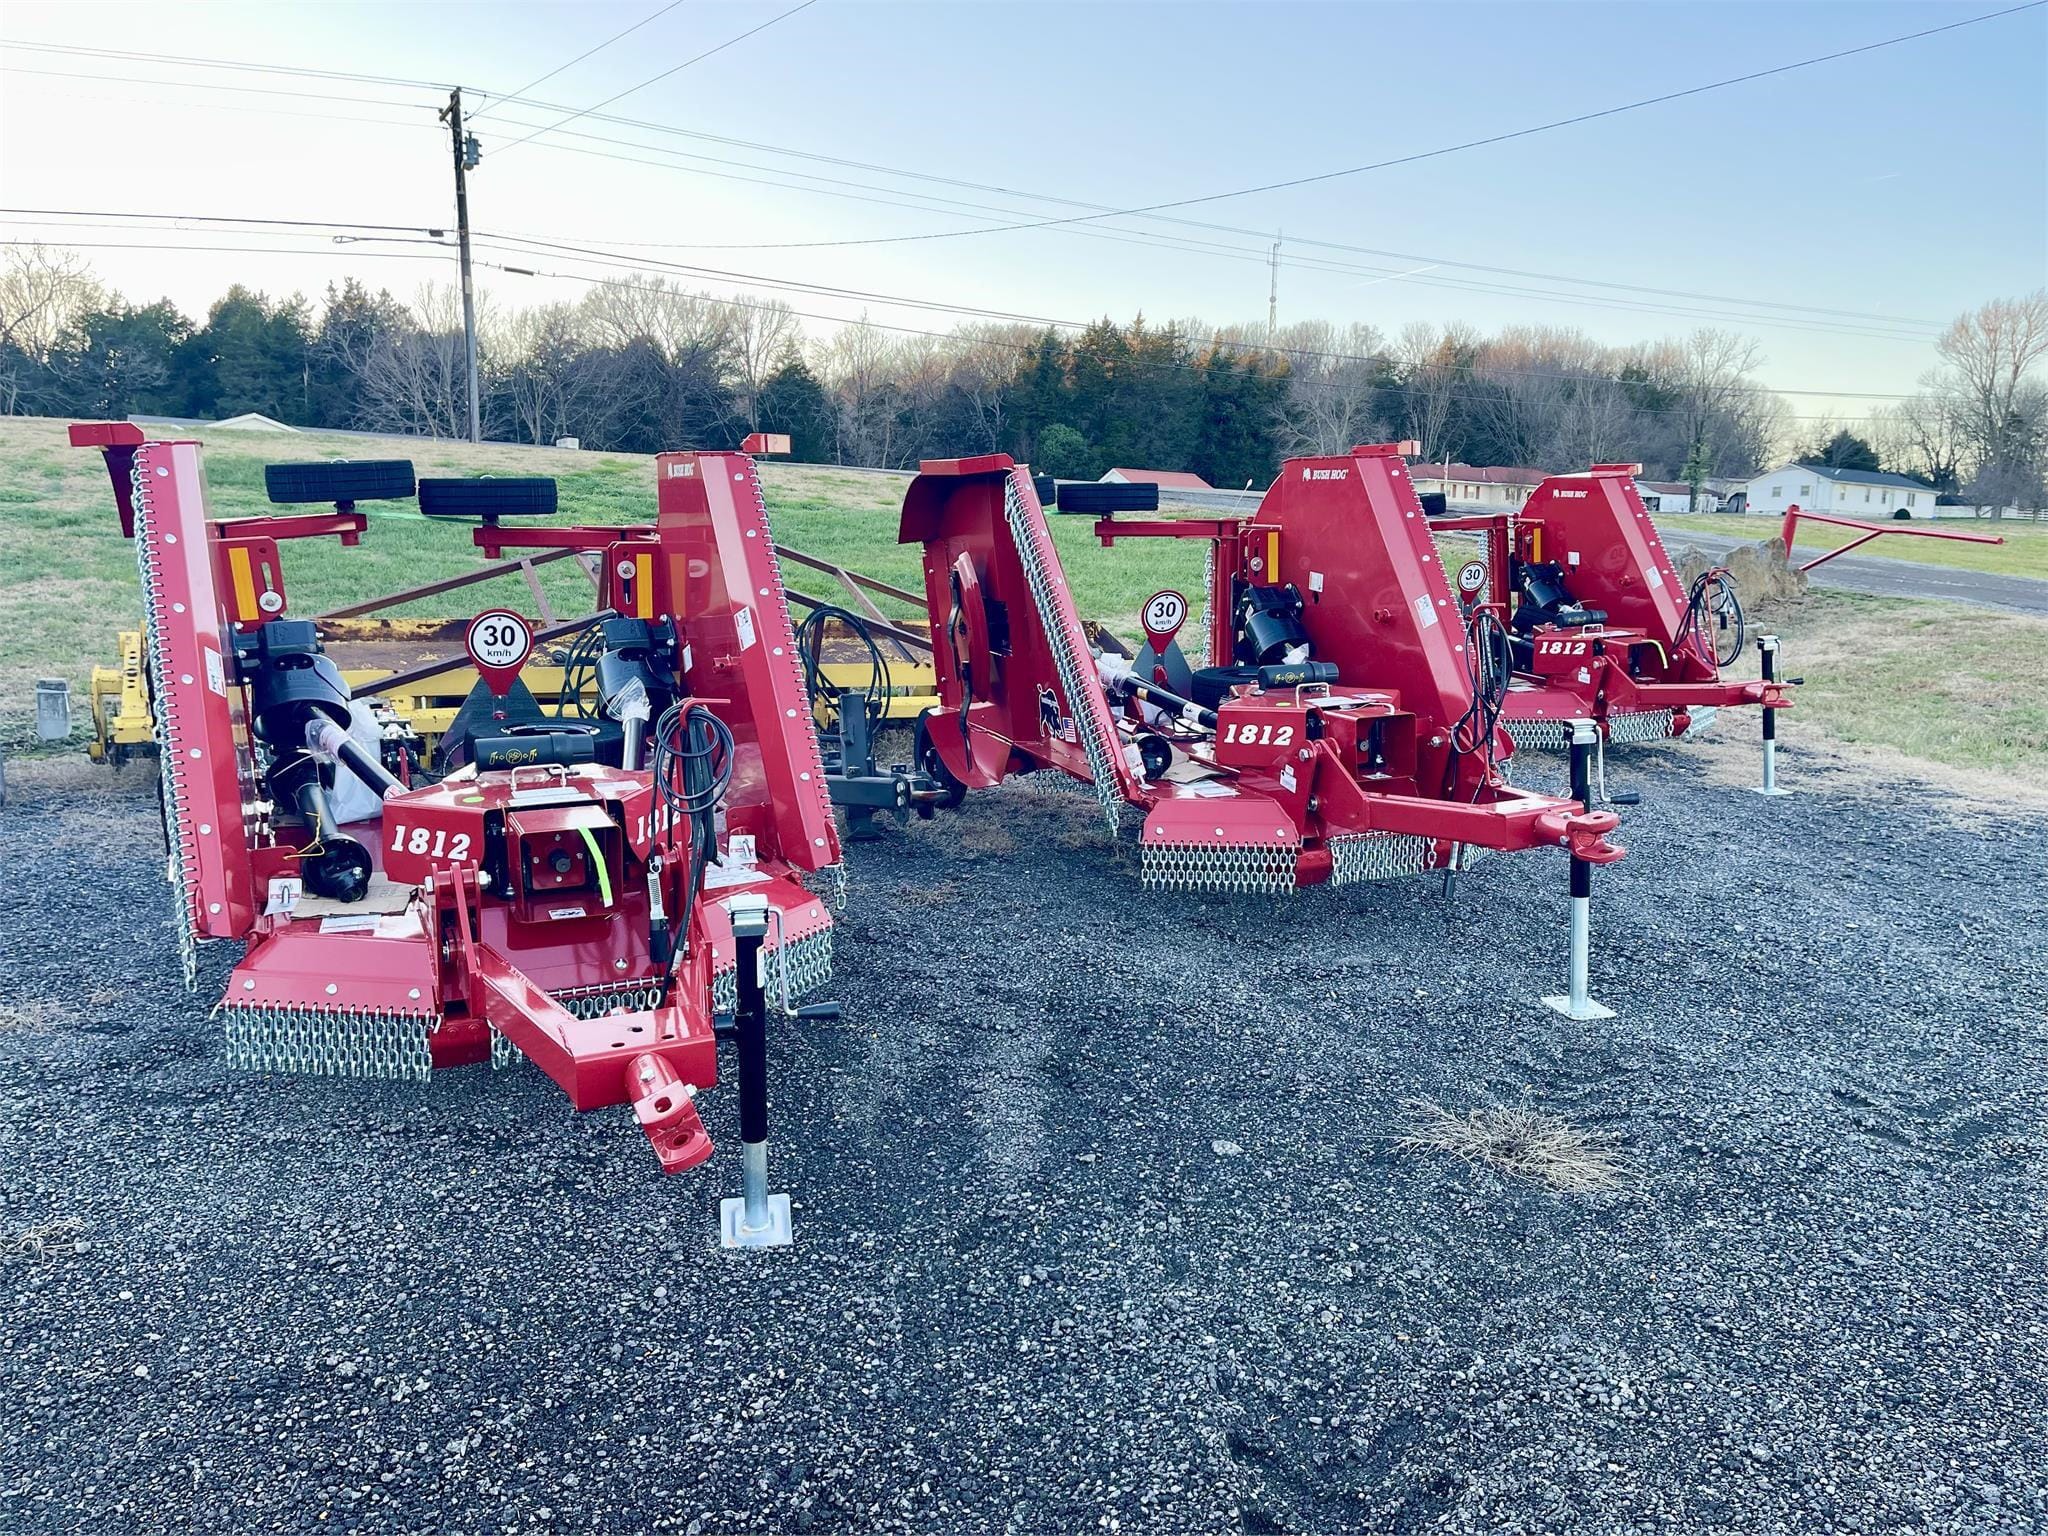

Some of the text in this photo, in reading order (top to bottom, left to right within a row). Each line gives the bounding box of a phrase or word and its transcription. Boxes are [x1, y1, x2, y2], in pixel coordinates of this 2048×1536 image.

[1312, 469, 1348, 480] BUSH HOG
[1465, 568, 1480, 580] 30
[1154, 601, 1176, 618] 30
[483, 624, 516, 647] 30
[487, 649, 512, 657] km/h
[1539, 641, 1587, 655] 1812
[1223, 723, 1294, 746] 1812
[391, 824, 471, 861] 1812
